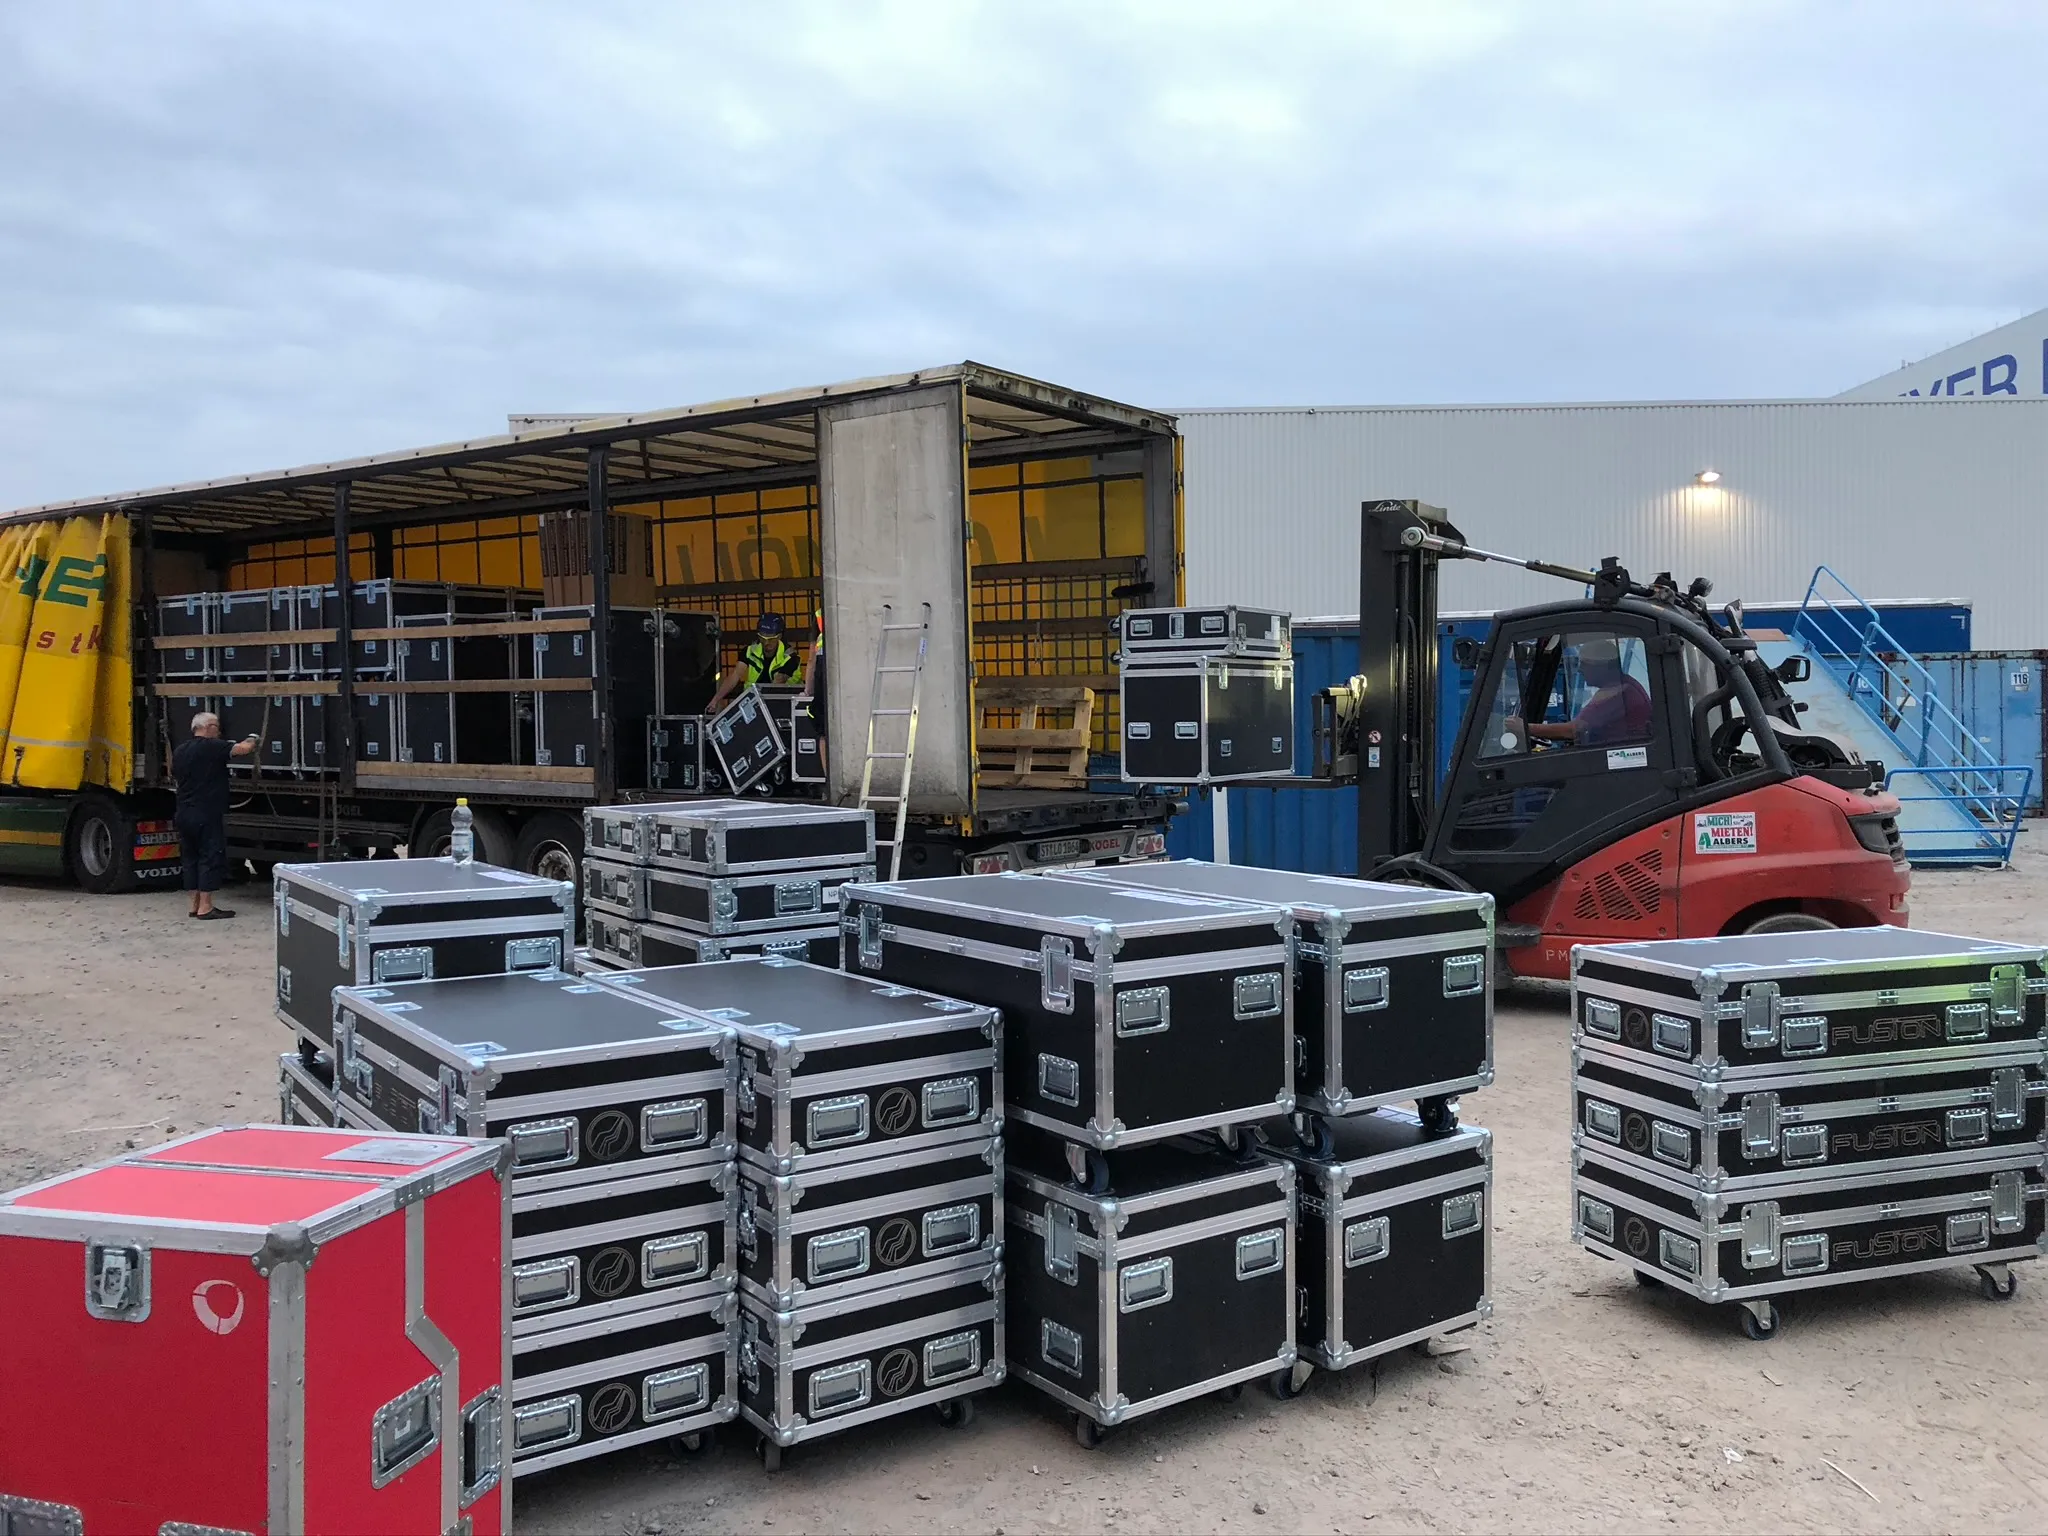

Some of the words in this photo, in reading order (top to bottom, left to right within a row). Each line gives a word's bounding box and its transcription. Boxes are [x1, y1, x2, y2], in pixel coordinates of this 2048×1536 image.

[1369, 500, 1401, 512] Linde
[2013, 673, 2028, 684] 116
[1711, 826, 1754, 838] MIETEN!
[1713, 837, 1749, 846] ALBERS
[1041, 843, 1049, 857] ST
[133, 865, 183, 879] VOLV
[1831, 1014, 1942, 1046] FUSION
[1832, 1119, 1942, 1154] FUSION
[1832, 1224, 1942, 1262] FUSION
